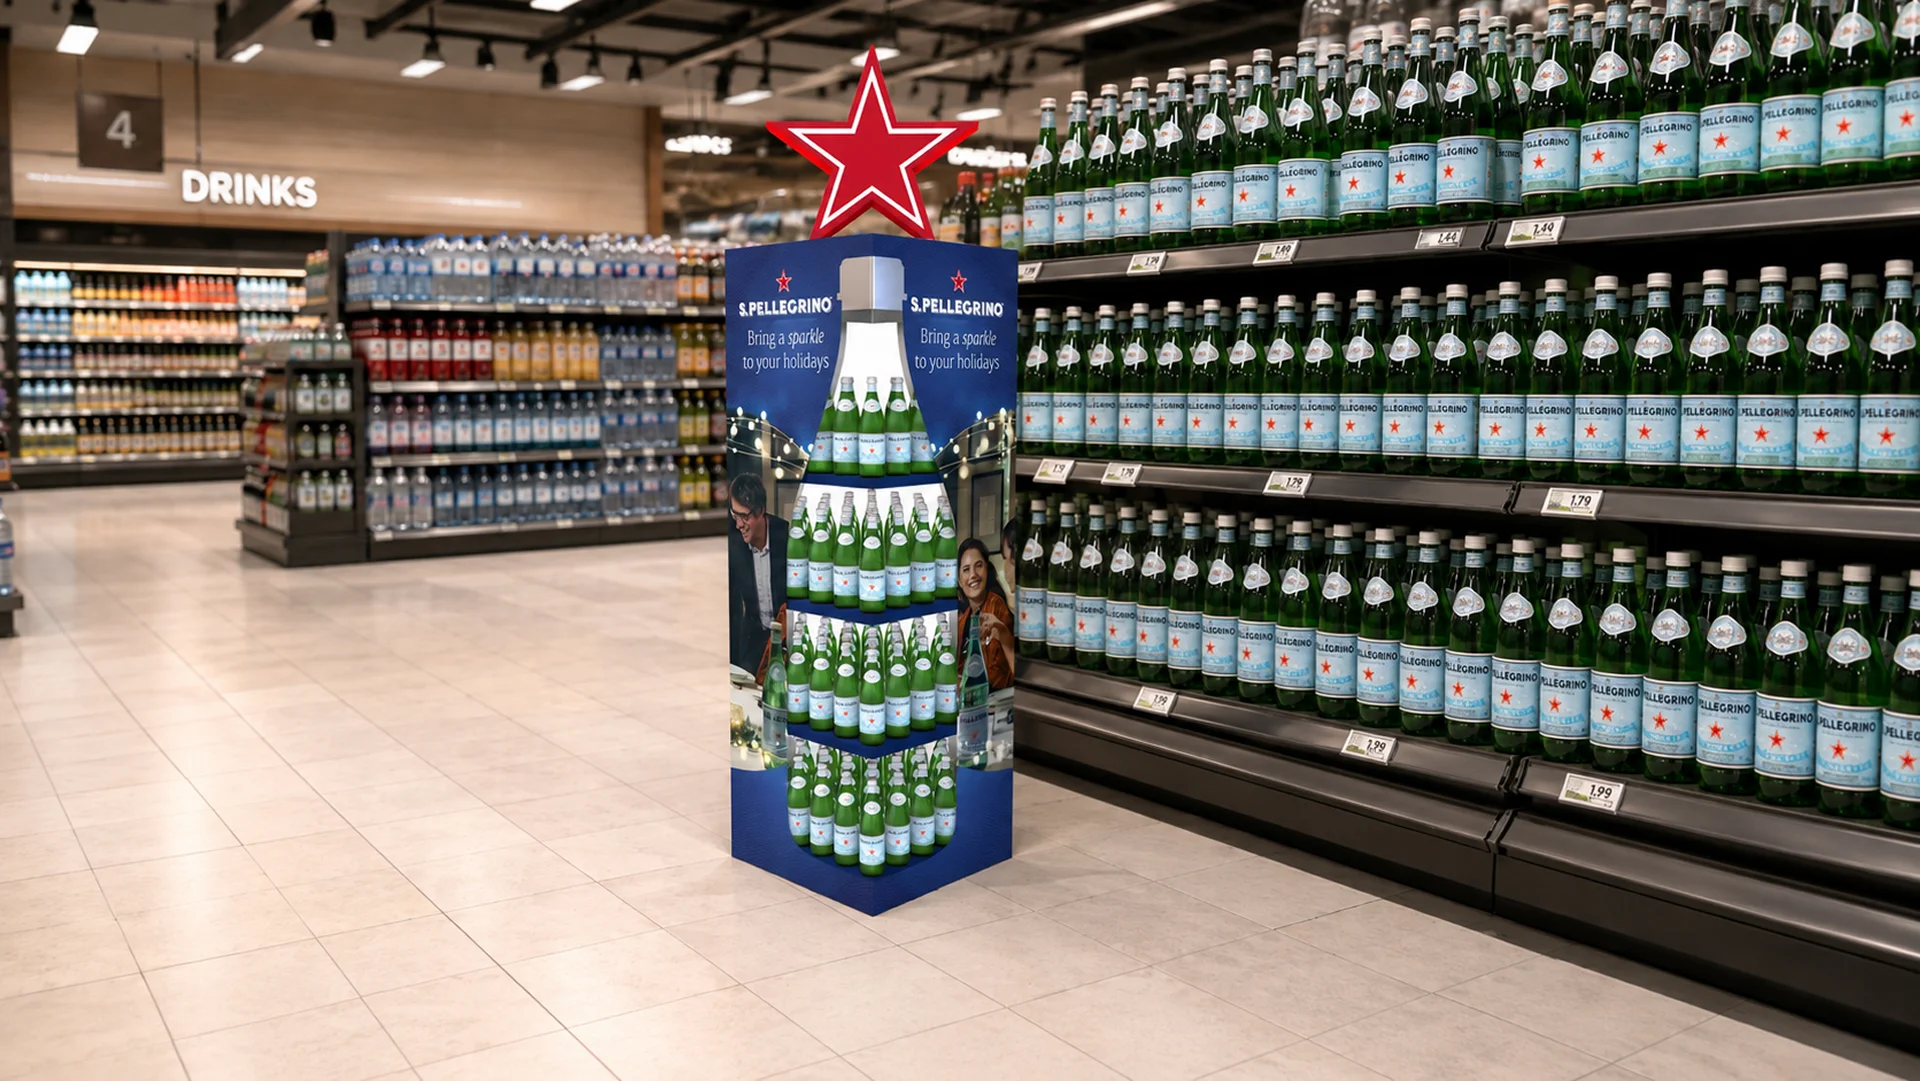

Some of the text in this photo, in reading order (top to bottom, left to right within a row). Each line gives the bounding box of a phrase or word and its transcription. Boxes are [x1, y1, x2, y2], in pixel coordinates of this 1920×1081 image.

[106, 110, 136, 149] 4
[182, 169, 318, 208] DRINKS
[739, 296, 833, 317] S.PELLEGRINO
[911, 296, 1004, 317] S.PELLEGRINO
[748, 327, 825, 350] Bring a sparkle
[921, 327, 997, 350] Bring a sparkle
[743, 352, 830, 375] to your holidays
[915, 352, 1000, 374] to your holidays
[1570, 495, 1592, 506] 1.79
[1367, 740, 1386, 752] 1.99
[1590, 785, 1612, 799] 1.99
